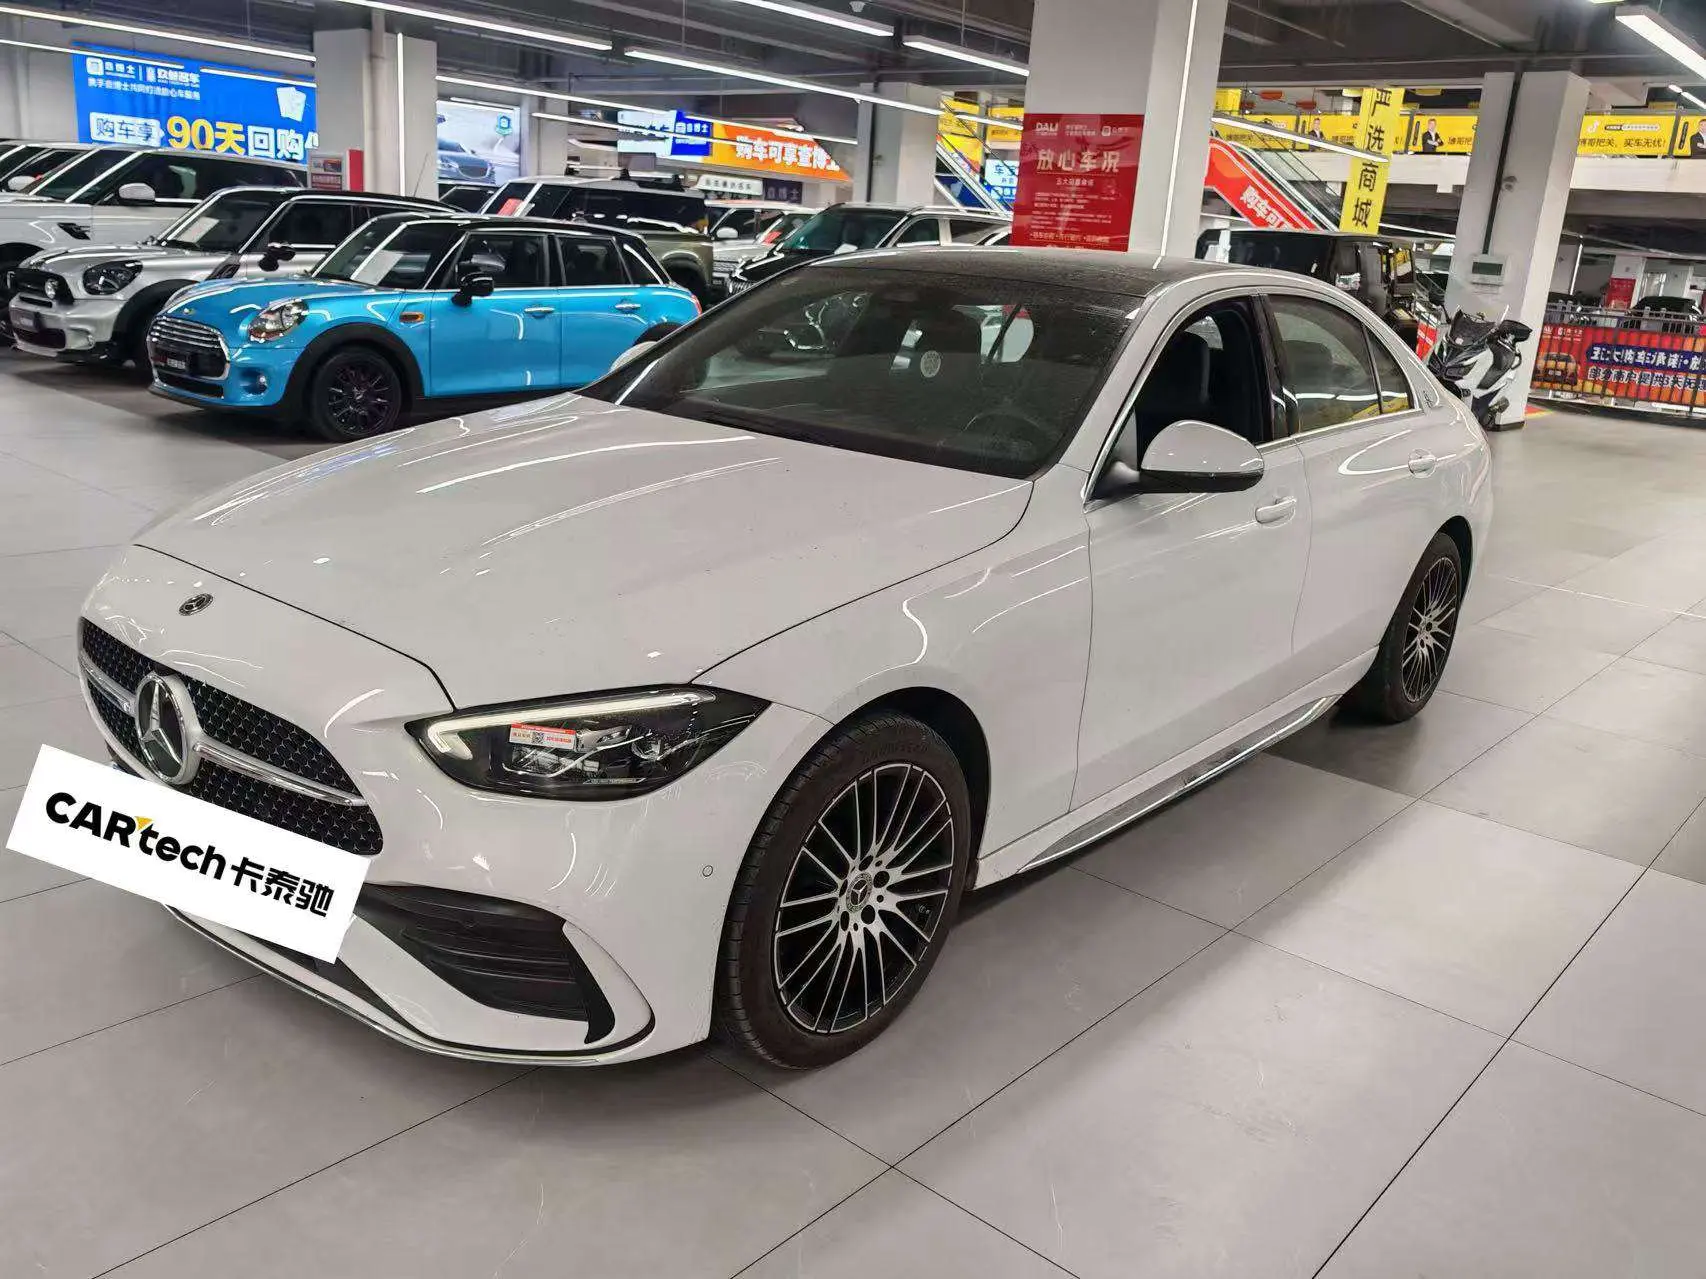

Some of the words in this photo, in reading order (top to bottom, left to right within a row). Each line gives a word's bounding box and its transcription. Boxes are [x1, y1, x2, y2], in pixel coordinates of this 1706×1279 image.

[1036, 149, 1120, 173] 放心车况
[1352, 89, 1392, 227] 严选商城
